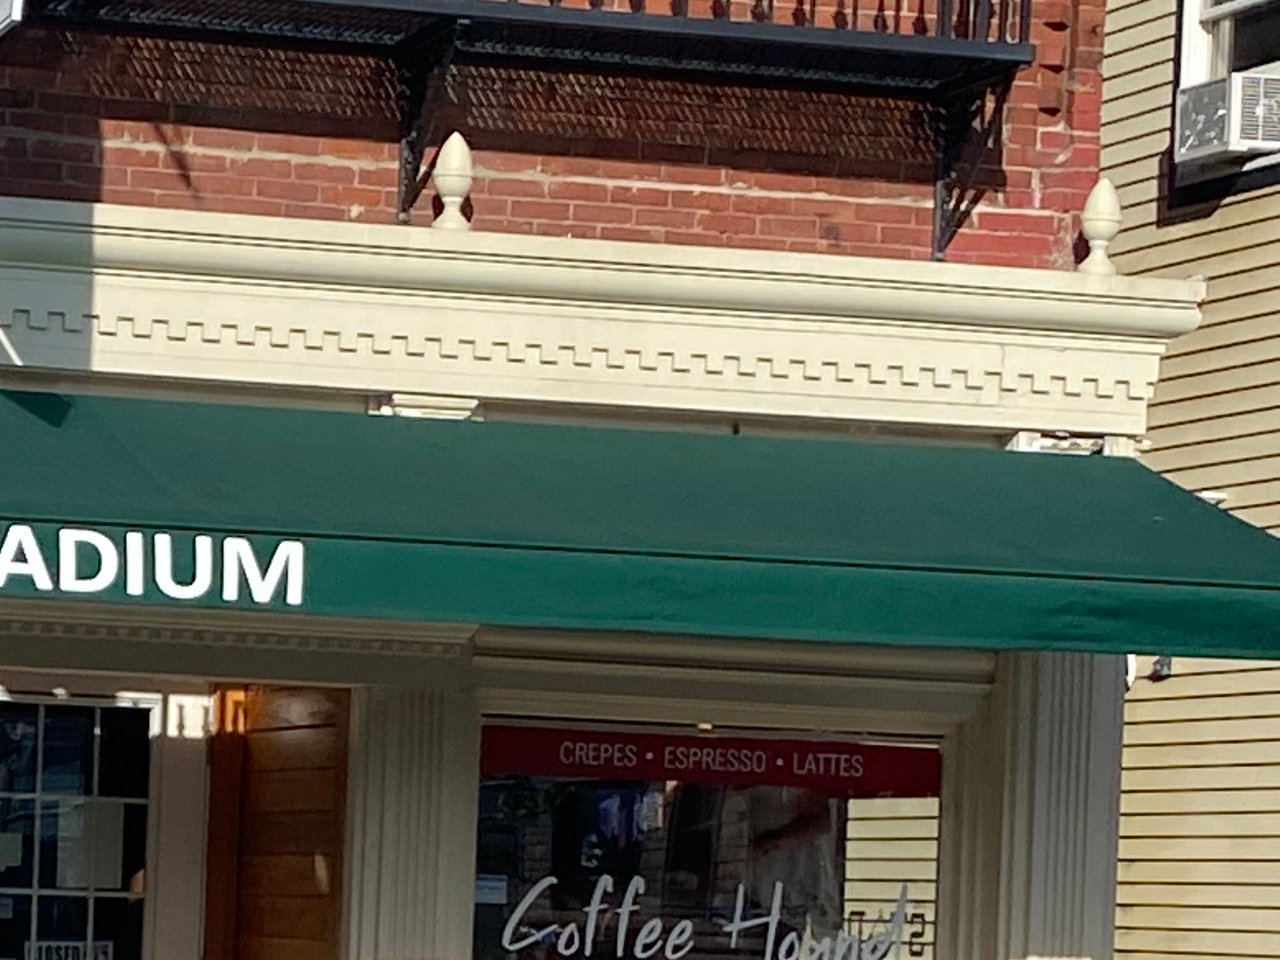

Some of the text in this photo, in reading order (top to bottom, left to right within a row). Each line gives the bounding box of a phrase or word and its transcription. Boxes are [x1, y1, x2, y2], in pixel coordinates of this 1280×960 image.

[560, 740, 864, 779] CREPES ESPRESSO LATTES
[502, 875, 695, 960] Coffee
